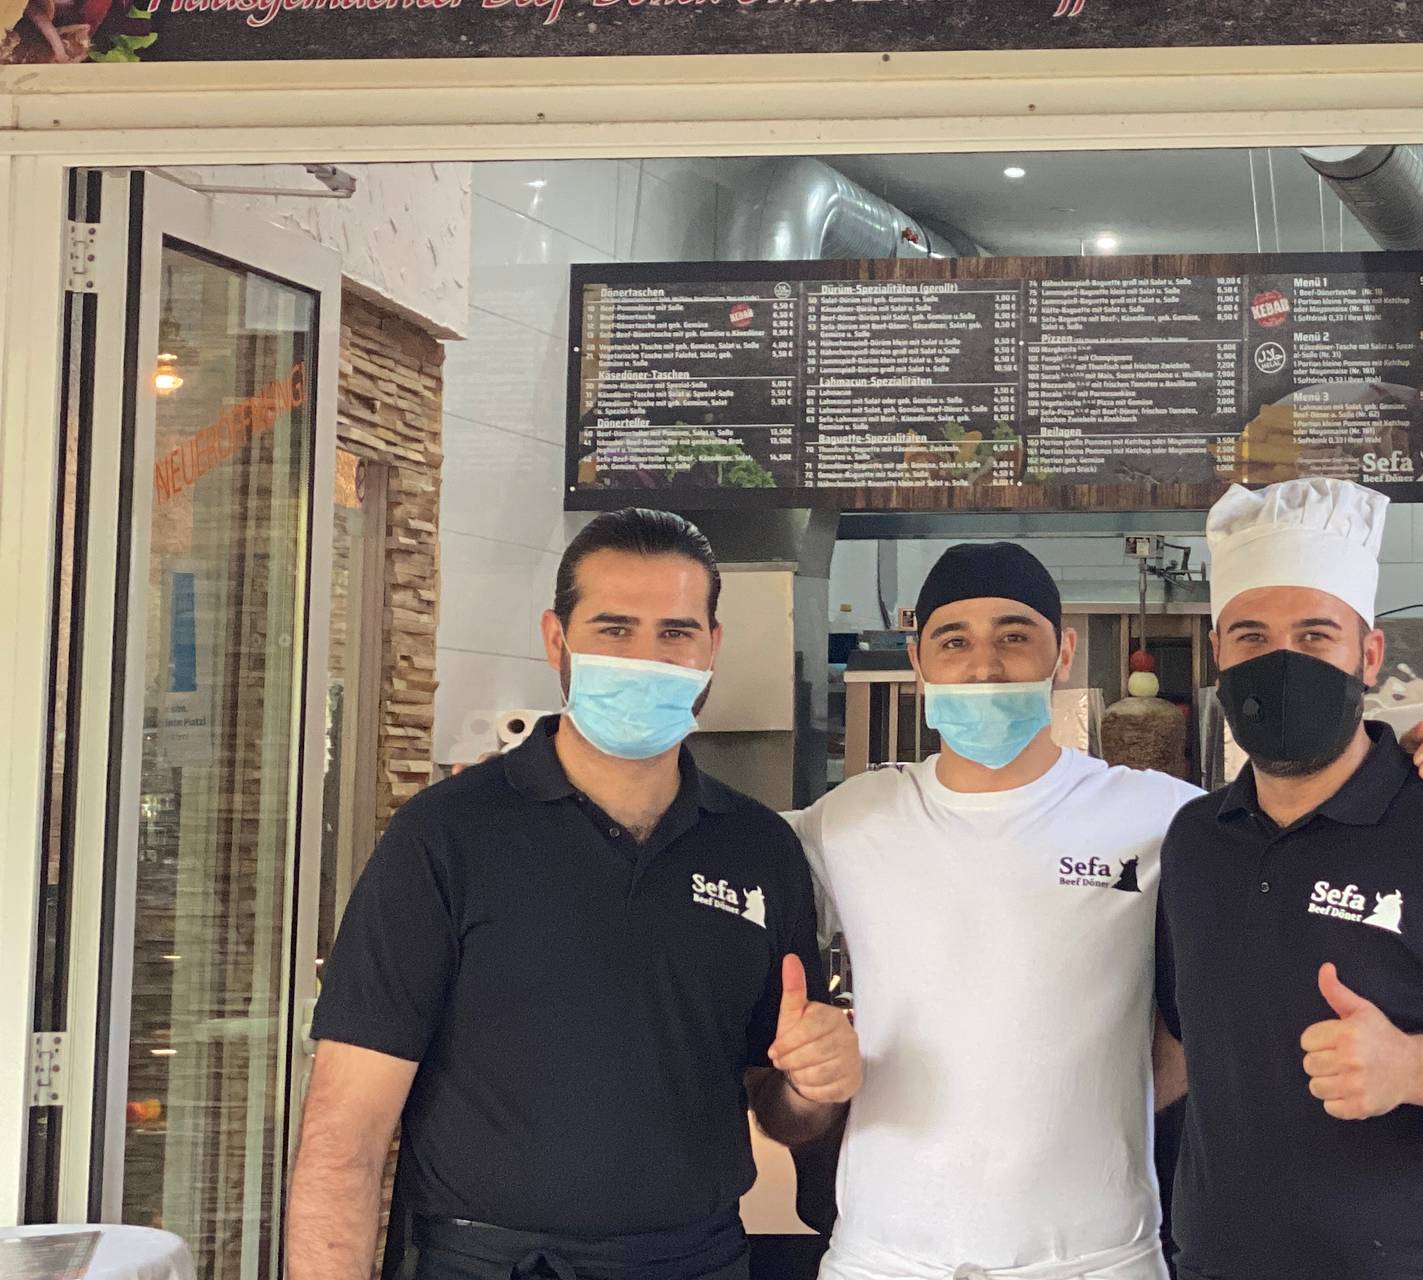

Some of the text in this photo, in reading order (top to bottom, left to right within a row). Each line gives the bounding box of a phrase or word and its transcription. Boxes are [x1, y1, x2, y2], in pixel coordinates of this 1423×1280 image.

[1294, 278, 1320, 287] Menü
[1323, 278, 1327, 287] 1
[601, 288, 664, 297] Dönertaschen
[821, 283, 958, 294] Dürüm-Spezialitäten (gerollt)
[1251, 298, 1290, 320] KEBAB
[1042, 334, 1072, 343] Pizzen
[1294, 333, 1329, 341] Menü 2
[599, 370, 689, 380] Käsedöner-Taschen
[820, 377, 931, 386] Lahmacun-Spezialitäten
[1294, 392, 1320, 401] Menü
[1323, 392, 1328, 401] 3
[597, 419, 650, 427] Dönerteller
[1041, 427, 1081, 437] Beilagen
[819, 434, 927, 444] Baguette-Spezialitäten
[1363, 451, 1414, 472] Sefa
[1363, 474, 1414, 482] Beef Döner
[1059, 856, 1111, 877] Sefa
[1059, 877, 1110, 888] Beef Döner
[691, 873, 739, 905] Sefa
[693, 893, 713, 906] Beef
[1311, 881, 1366, 911] Sefa
[1308, 903, 1363, 922] Beef Döner
